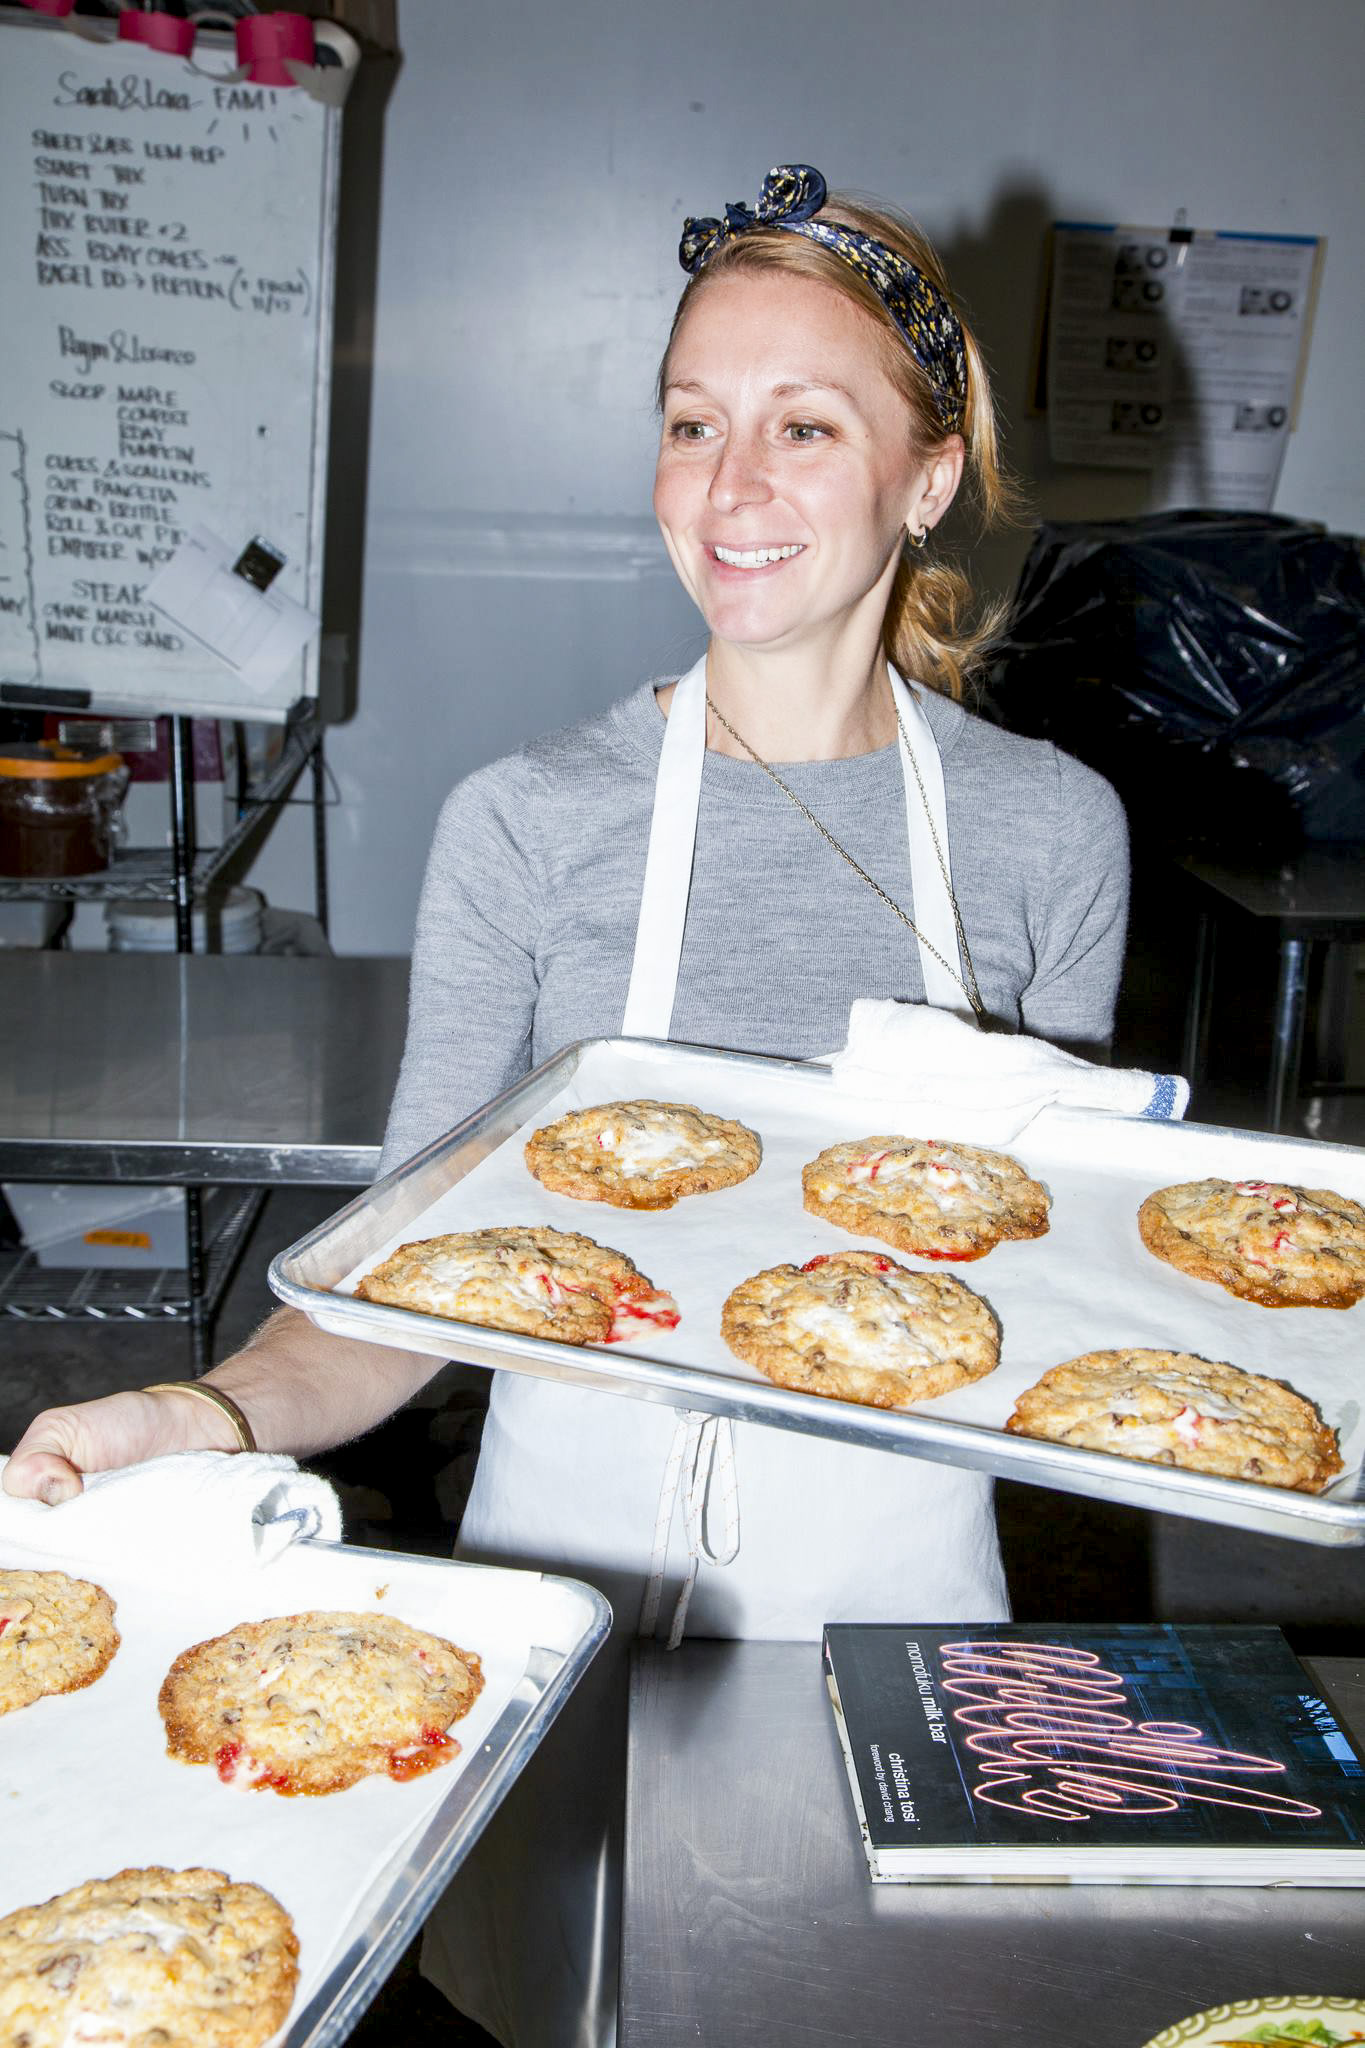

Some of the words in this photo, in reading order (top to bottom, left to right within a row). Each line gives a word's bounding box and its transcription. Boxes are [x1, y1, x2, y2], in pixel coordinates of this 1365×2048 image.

[117, 386, 177, 407] MAPLE
[906, 1641, 934, 1695] momofuku
[922, 1694, 943, 1723] milk
[929, 1723, 948, 1744] bar
[870, 1744, 884, 1774] foreword
[879, 1781, 892, 1801] david
[889, 1753, 911, 1799] christina
[901, 1799, 920, 1822] tosi
[883, 1801, 895, 1823] chang
